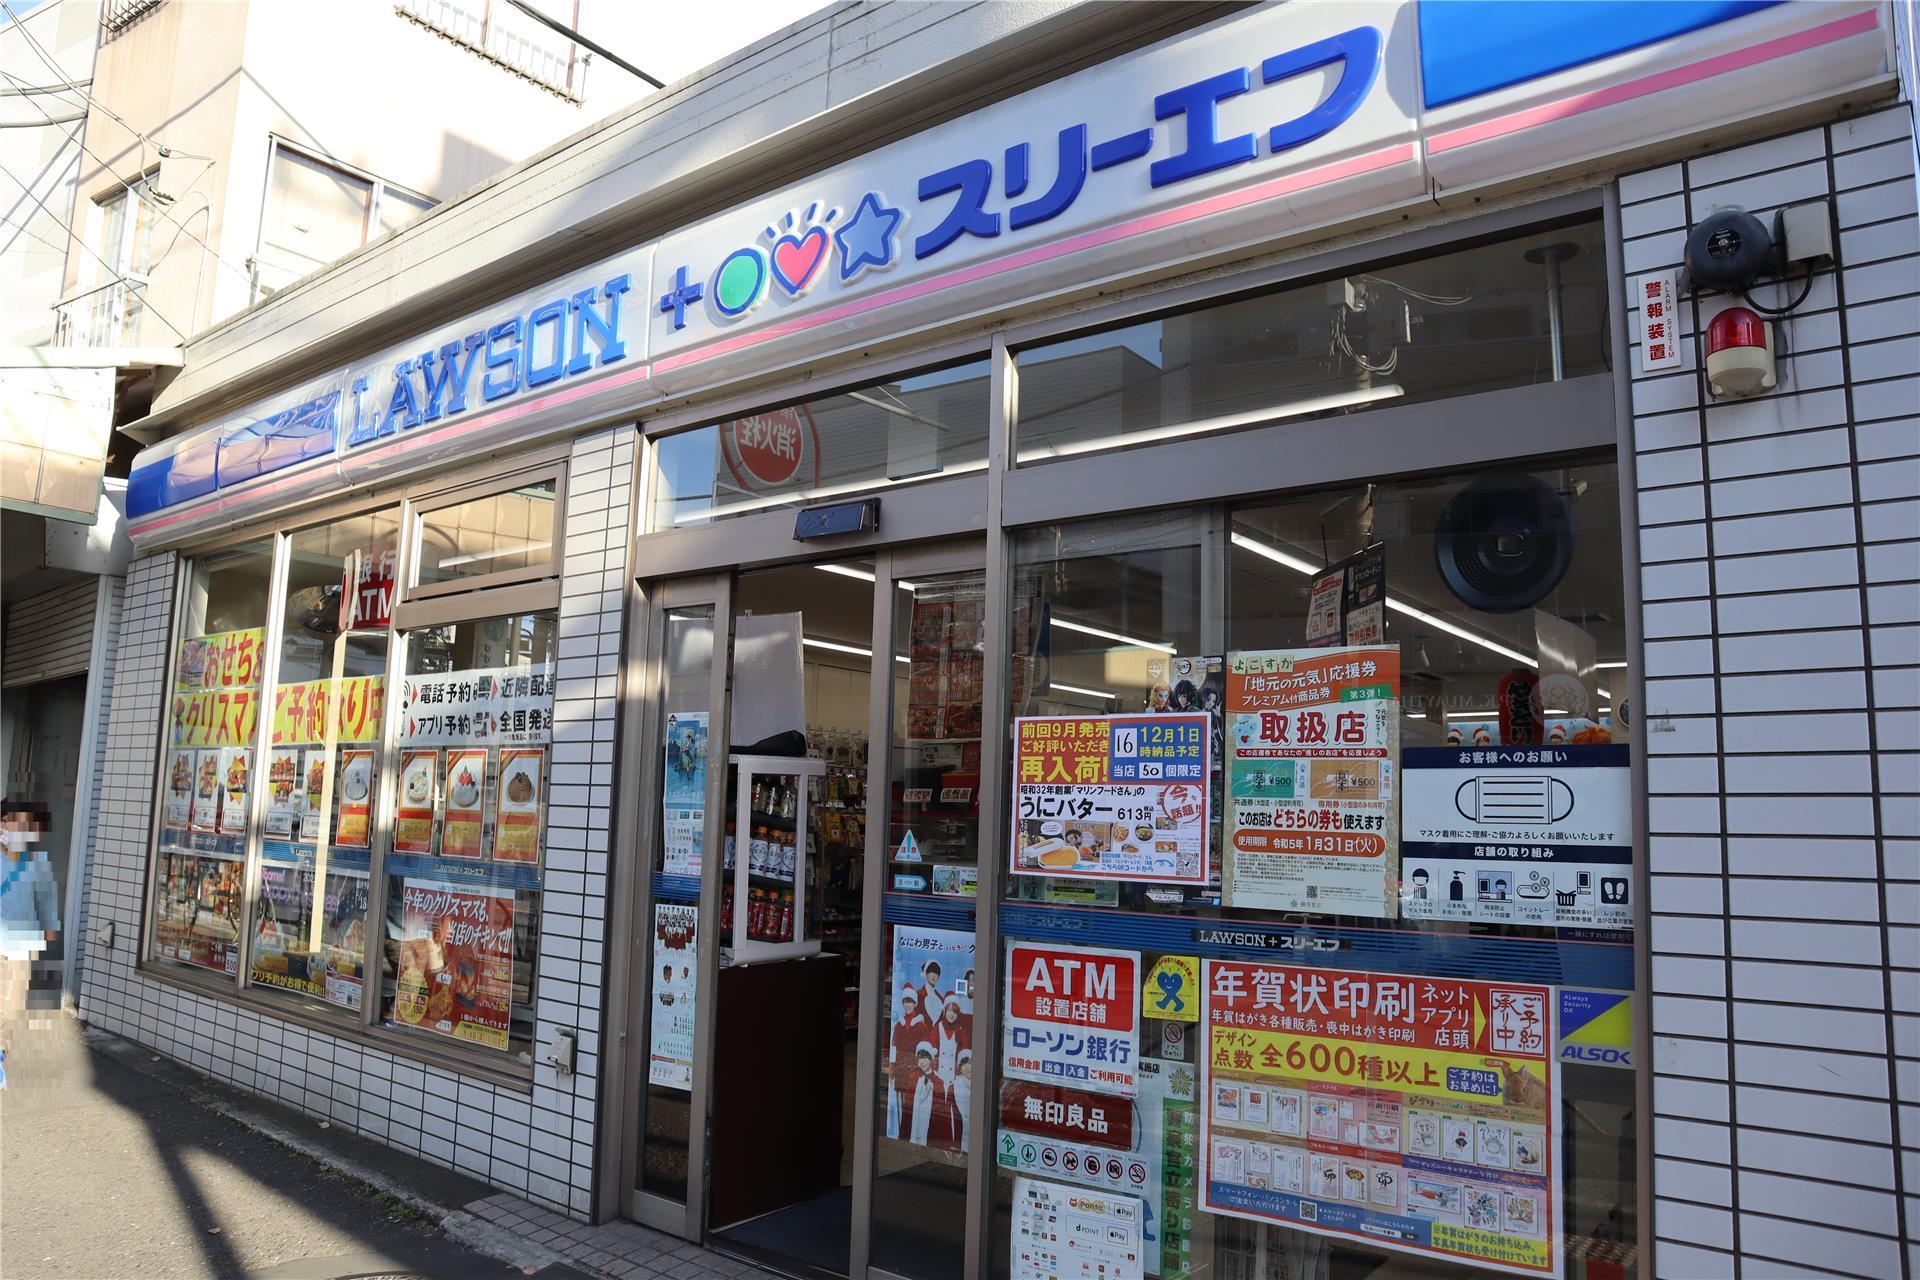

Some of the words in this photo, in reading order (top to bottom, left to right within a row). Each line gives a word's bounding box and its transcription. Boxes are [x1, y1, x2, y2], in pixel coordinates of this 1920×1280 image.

[348, 273, 632, 446] LAWSON
[915, 25, 1384, 260] スリーエフ
[1664, 279, 1673, 312] ALARM
[1645, 281, 1666, 361] 警報装置
[1666, 318, 1675, 358] SYSTEM
[353, 587, 394, 622] ATM
[1234, 657, 1294, 671] よこすか
[1243, 661, 1376, 692] 「地元の元気」応援券
[420, 681, 471, 704] 電話予約
[1242, 686, 1331, 706] プレミアム付商品券
[418, 713, 471, 737] アプリ予約
[1022, 721, 1110, 738] 前回9月発売
[1140, 726, 1199, 743] 12月1日
[1259, 710, 1366, 745] 取扱店
[1022, 739, 1110, 752] ご好評いただき
[1116, 731, 1134, 755] 16
[1140, 745, 1199, 758] 時納品予定
[1459, 751, 1568, 764] お客様へのお願い
[1020, 756, 1109, 784] 再入荷!
[1114, 764, 1135, 778] 当店
[1142, 766, 1159, 776] 50
[1165, 764, 1201, 778] 個限定
[1020, 796, 1113, 819] うにバター
[1239, 808, 1385, 831] このお店はどちらの券も使えます
[1238, 836, 1267, 848] 使用期限
[1474, 846, 1554, 858] 店舗の取り組み
[404, 887, 489, 922] 今年のクリスマスも、
[898, 936, 944, 951] なにわ男子と
[1200, 930, 1266, 947] LAWSON
[1281, 936, 1340, 952] スリーエフ
[1025, 957, 1116, 1001] ATM
[1211, 966, 1416, 1024] 年賀状印刷
[1422, 983, 1470, 1006] ネット
[1564, 1001, 1592, 1009] Security
[1035, 997, 1107, 1024] 設置店舗
[1421, 1007, 1470, 1028] アプリ
[1211, 1008, 1416, 1043] 年賀はがき各種販売・喪中はがき印刷
[1517, 996, 1542, 1052] ご予約
[1013, 1027, 1131, 1064] ローソン銀行
[1214, 1030, 1258, 1047] デザイン
[1434, 1029, 1470, 1050] 店頭
[1214, 1047, 1255, 1070] 点数
[1260, 1041, 1441, 1087] 全600種以上
[1561, 1045, 1632, 1065] ALSOK
[1008, 1056, 1041, 1071] 信用金庫
[1044, 1061, 1063, 1074] 出金
[1068, 1066, 1086, 1078] 入金
[1089, 1068, 1134, 1086] ご利用可能
[1448, 1068, 1495, 1083] ご予約は
[1449, 1080, 1497, 1095] お早めに!
[1024, 1095, 1108, 1135] 無印良品
[1080, 1200, 1104, 1211] Ponta
[1121, 1208, 1133, 1217] Pay
[1081, 1227, 1099, 1235] POINT
[1114, 1229, 1126, 1240] Pay
